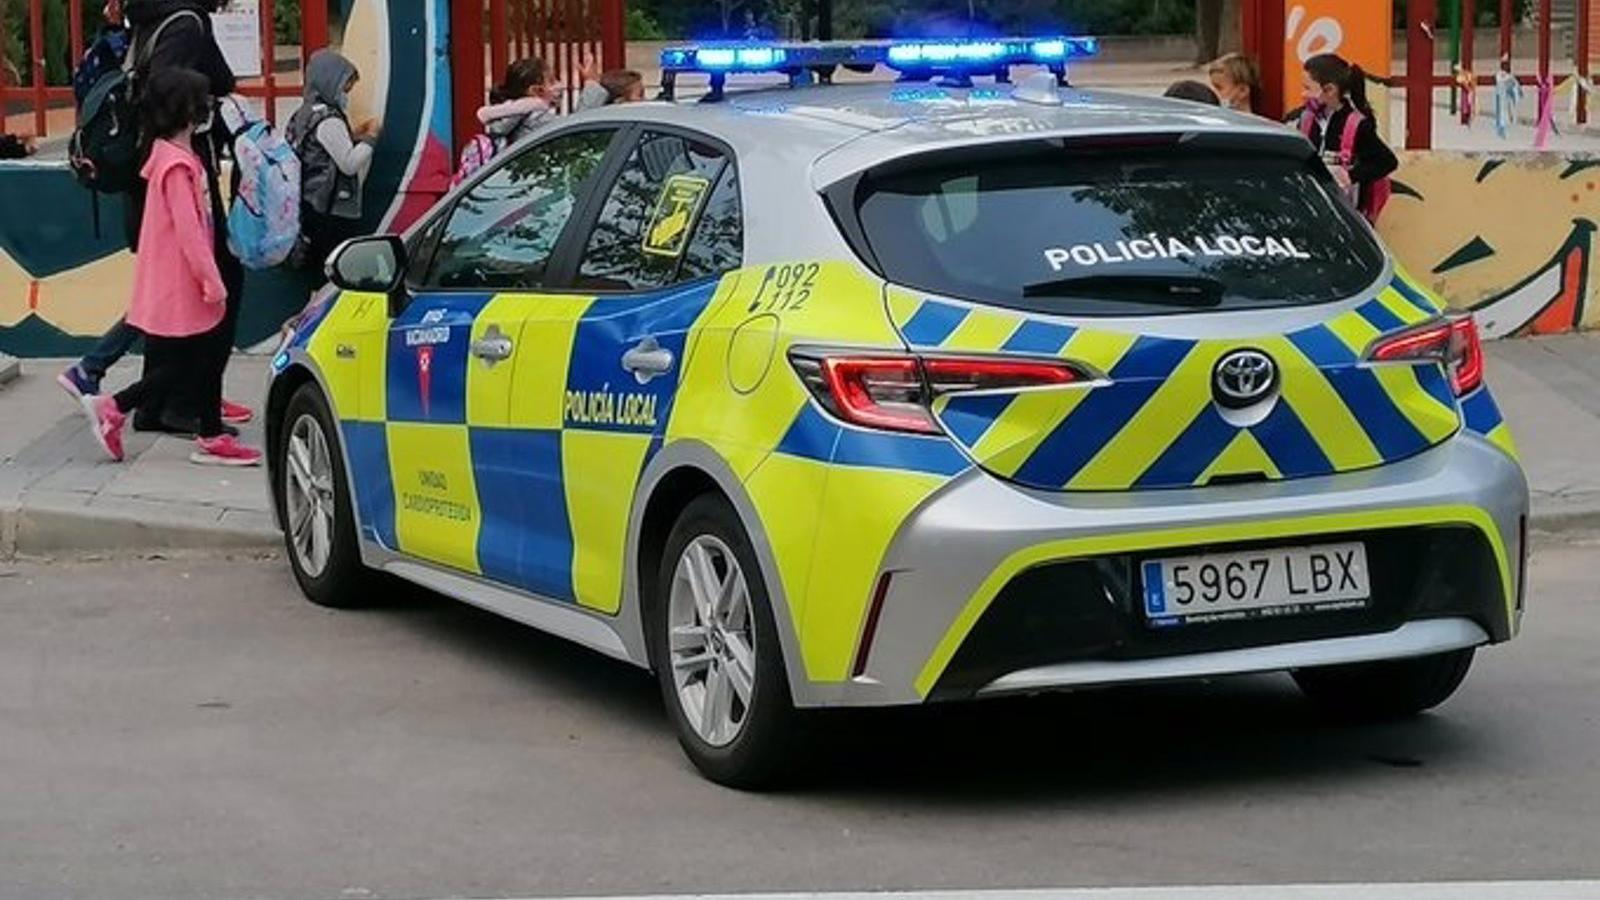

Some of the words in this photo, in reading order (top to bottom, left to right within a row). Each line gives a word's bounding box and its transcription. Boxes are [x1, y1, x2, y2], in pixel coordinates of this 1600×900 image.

[1044, 233, 1193, 271] POLICÍA
[1196, 234, 1310, 259] LOCAL
[776, 262, 820, 288] 092
[766, 289, 810, 310] 112
[564, 381, 614, 423] POLICÍA
[616, 392, 658, 426] LOCAL
[1173, 558, 1270, 605] 5967
[1284, 550, 1359, 595] LBX
